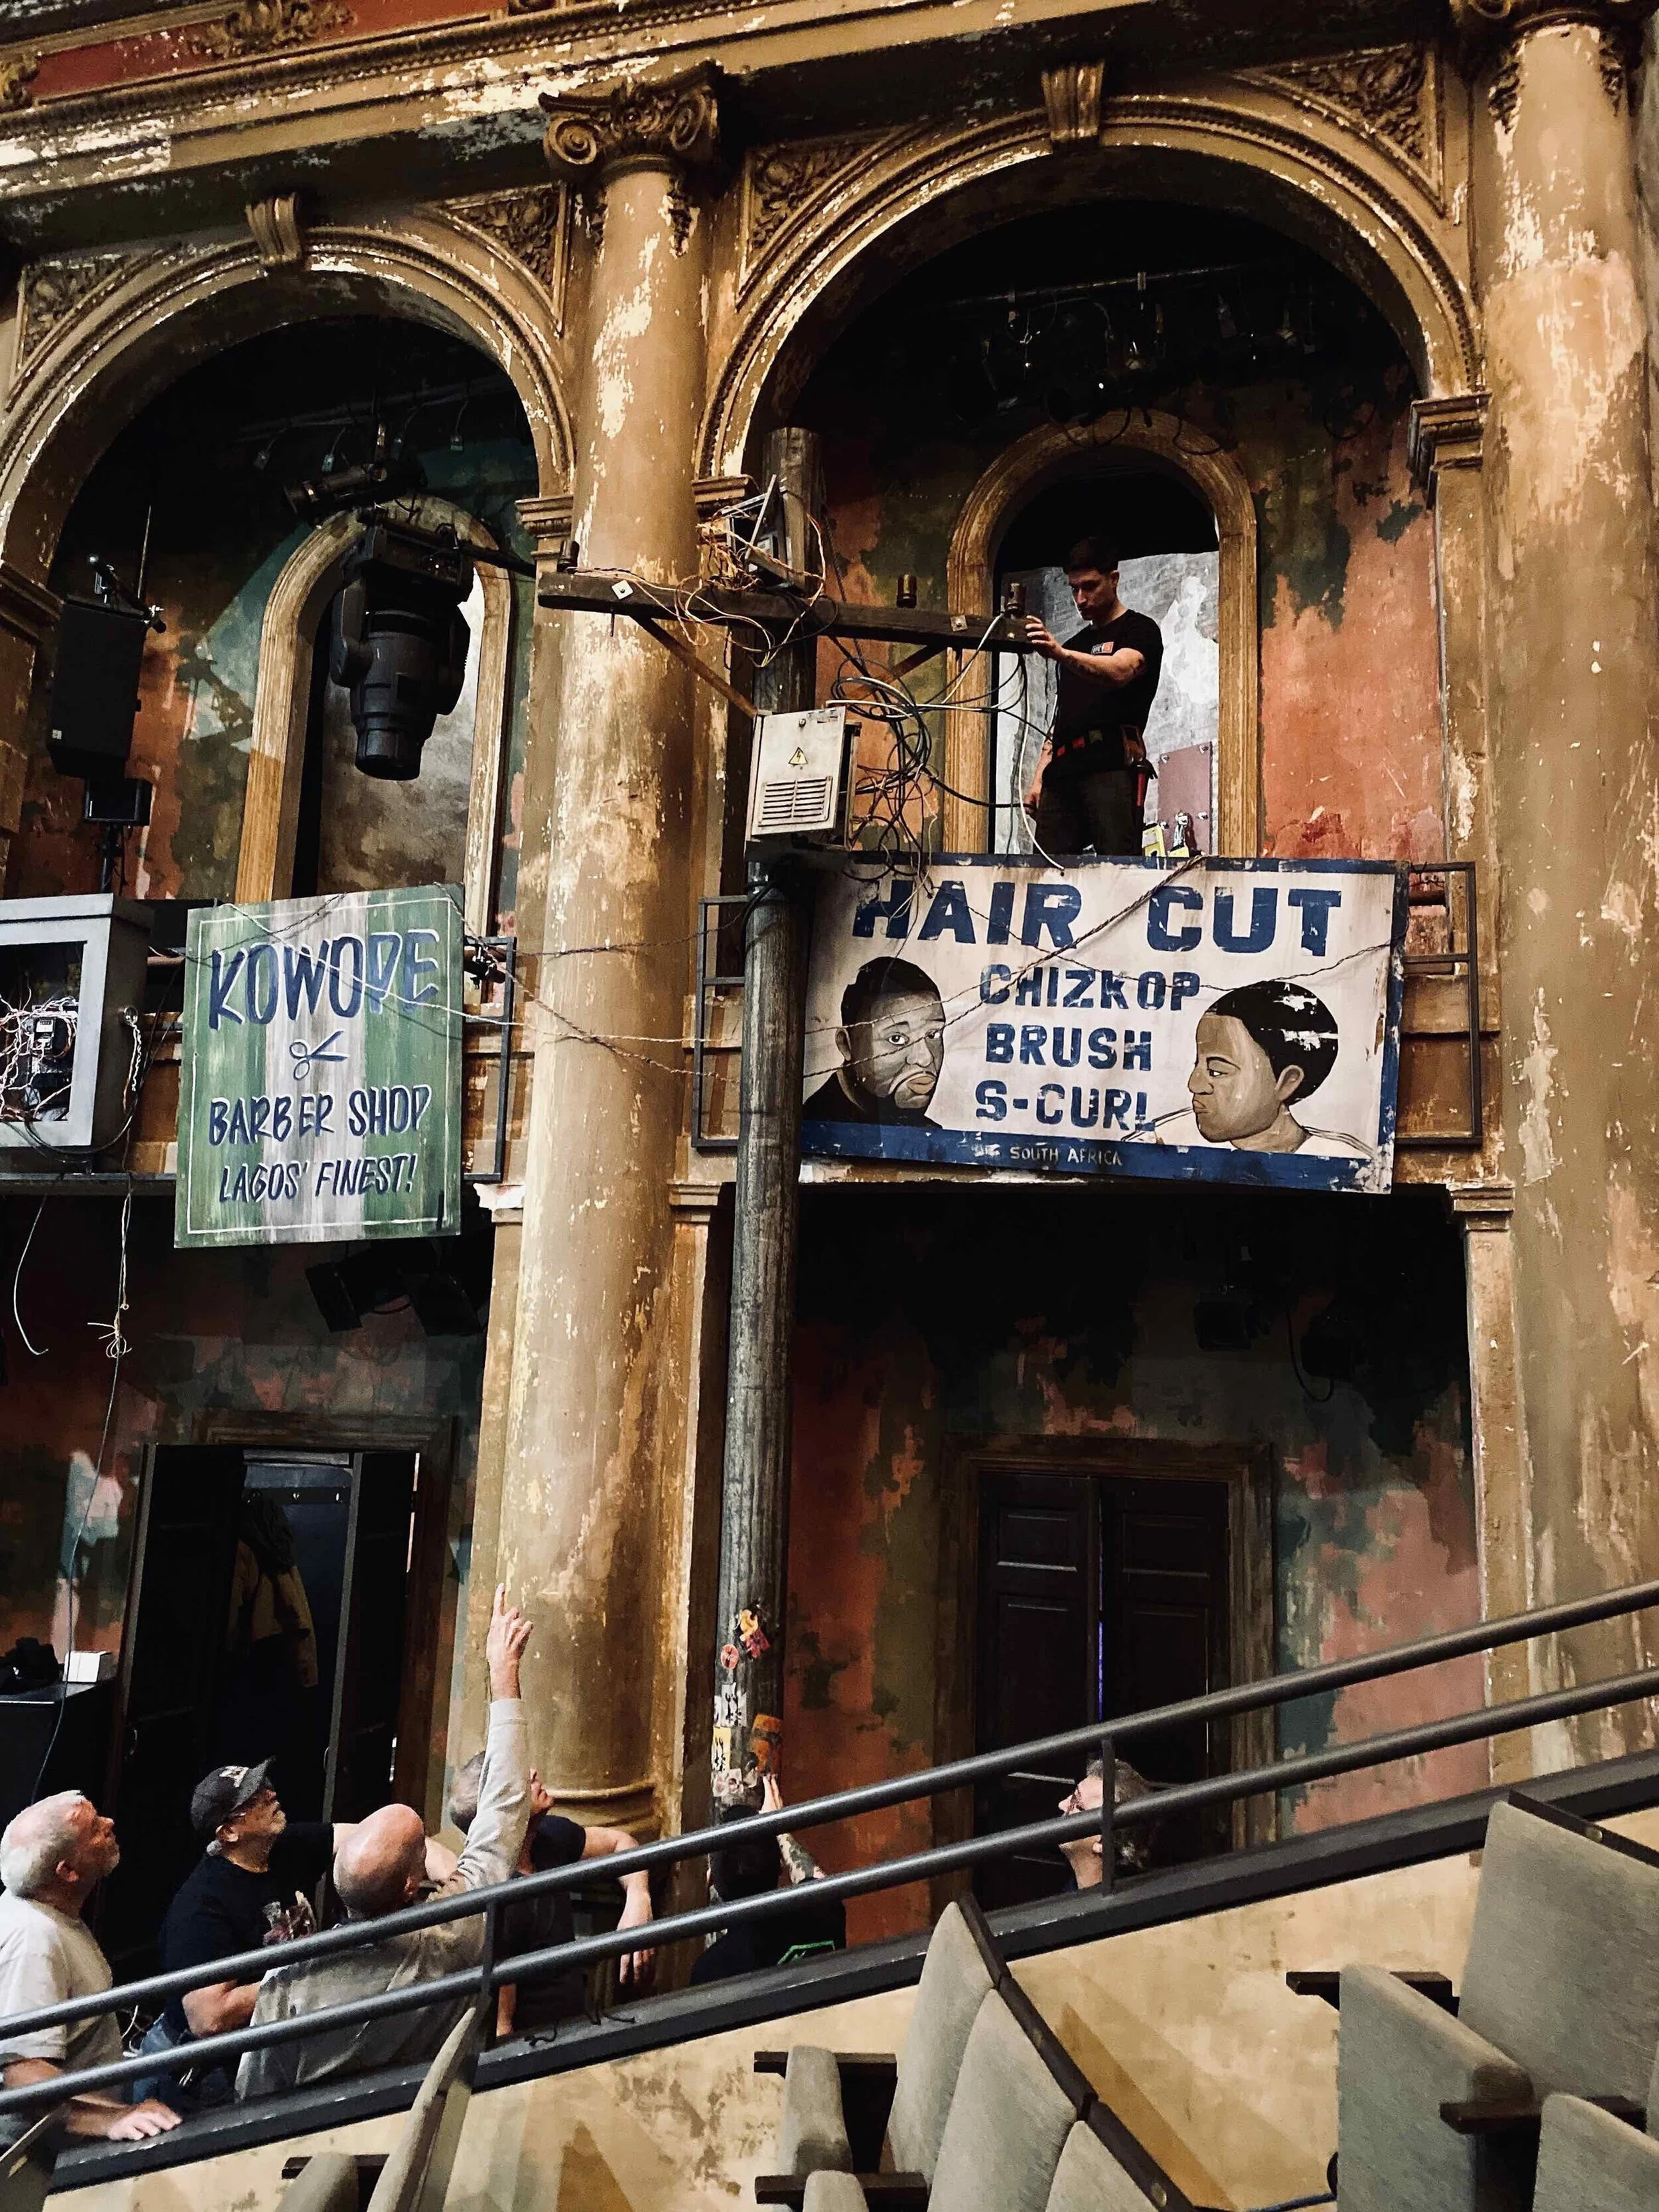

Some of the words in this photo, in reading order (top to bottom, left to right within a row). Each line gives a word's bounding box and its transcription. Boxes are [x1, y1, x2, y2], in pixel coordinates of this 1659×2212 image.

[852, 879, 1082, 949] HAIR
[1147, 886, 1342, 956] CUT
[979, 964, 1201, 1011] CHIZKOP
[985, 1023, 1152, 1071] BRUSH
[208, 1093, 334, 1146] BARBER
[348, 1084, 432, 1138] SHOP
[975, 1079, 1156, 1132] S-CURL
[315, 1153, 418, 1197] FINEST!
[1009, 1145, 1059, 1161] SOUTH
[1066, 1145, 1123, 1166] AFRICA
